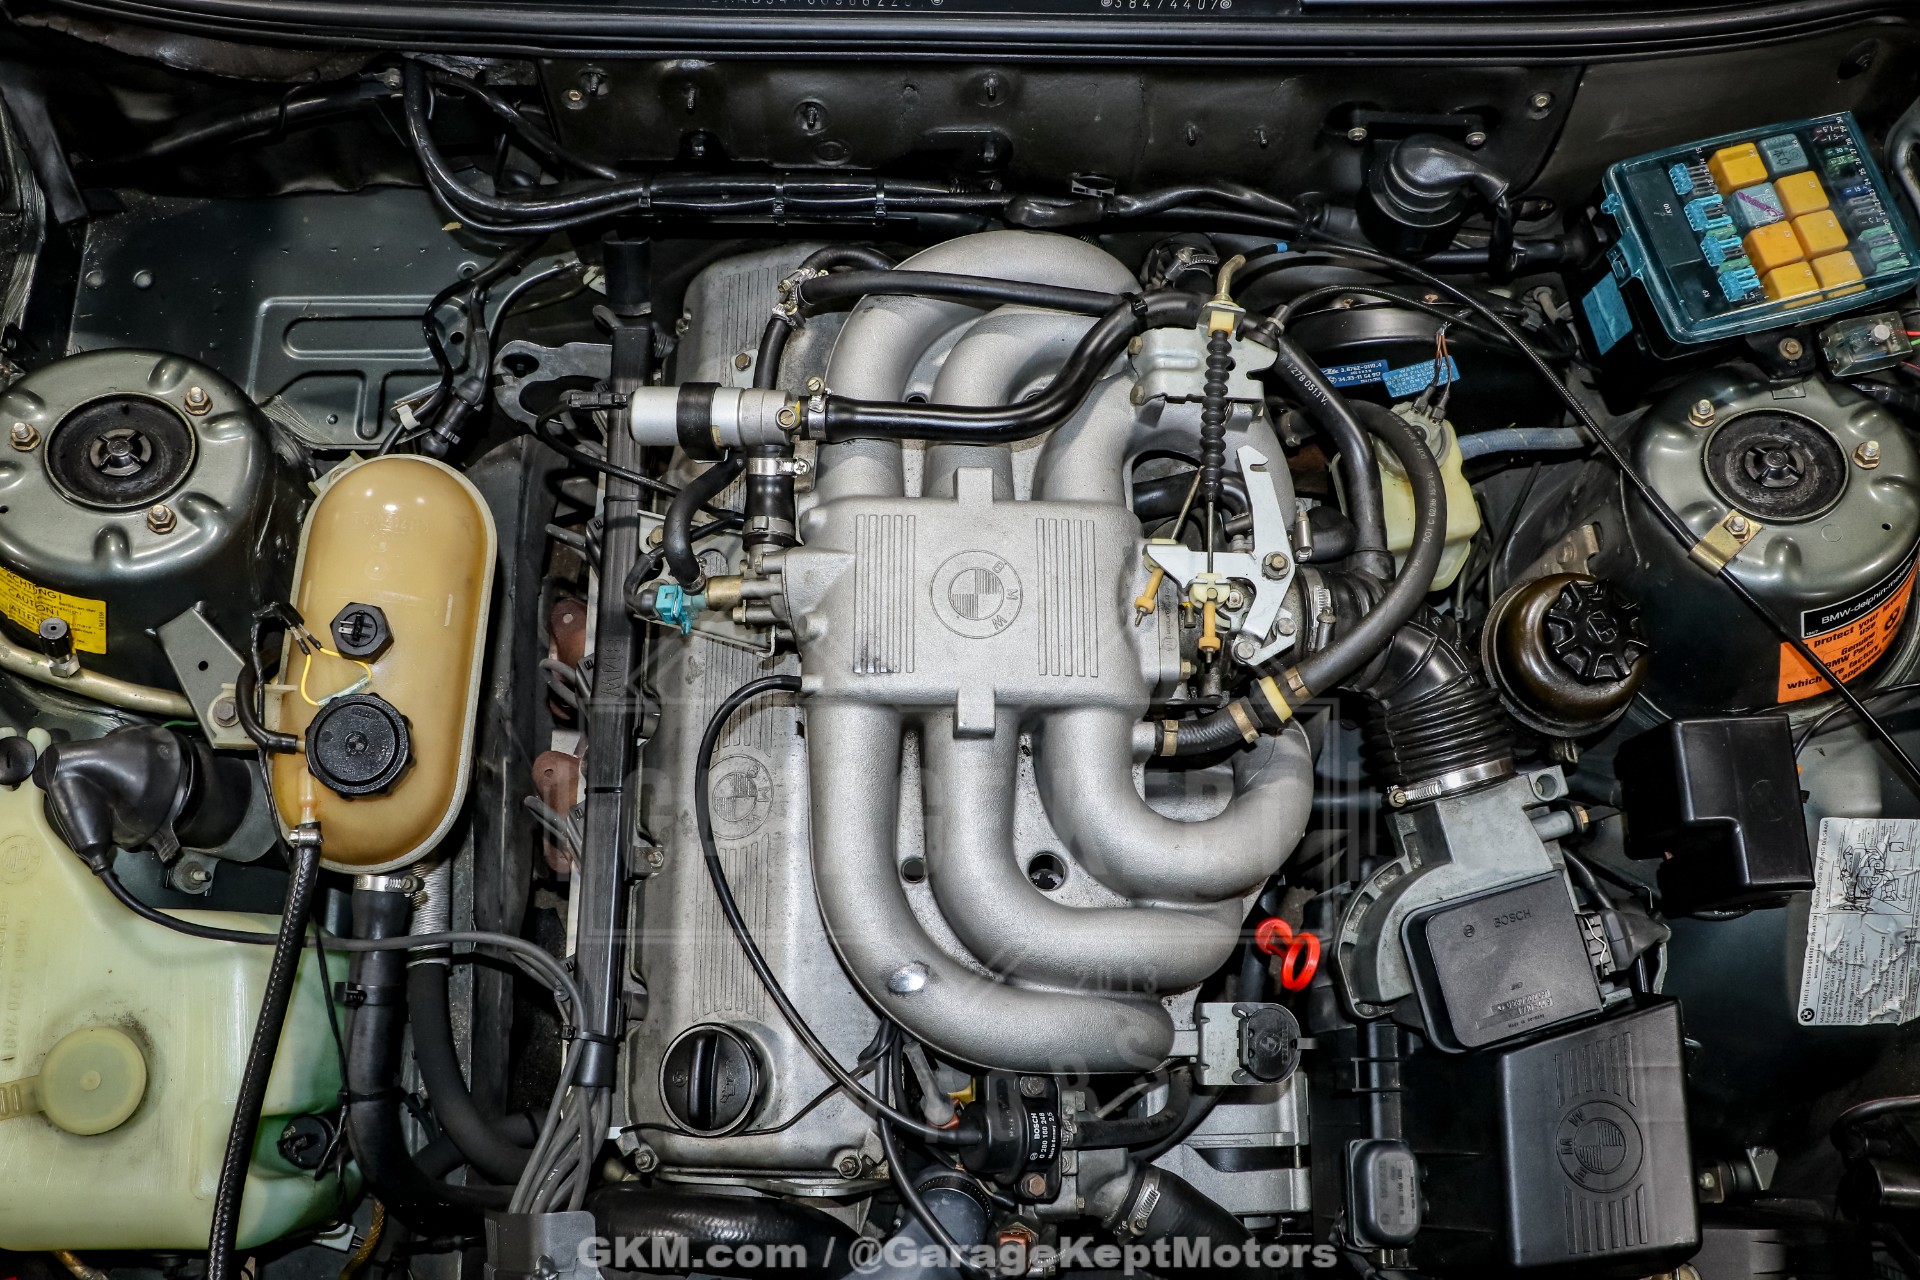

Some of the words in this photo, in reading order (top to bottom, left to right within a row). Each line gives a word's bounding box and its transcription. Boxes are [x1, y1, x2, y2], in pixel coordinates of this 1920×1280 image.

[1290, 366, 1306, 382] 278
[1423, 528, 1433, 543] DOT
[1814, 626, 1854, 648] protect
[1858, 612, 1879, 631] your
[1859, 622, 1876, 635] use
[1825, 654, 1850, 668] BMW
[1853, 639, 1875, 656] Parts
[1841, 631, 1875, 655] Genuine
[599, 640, 625, 697] BMW
[1787, 675, 1823, 689] which
[1849, 644, 1879, 668] factory
[1493, 908, 1532, 928] BOSCH
[1030, 1112, 1040, 1139] BOSCH
[1039, 1112, 1047, 1124] 248
